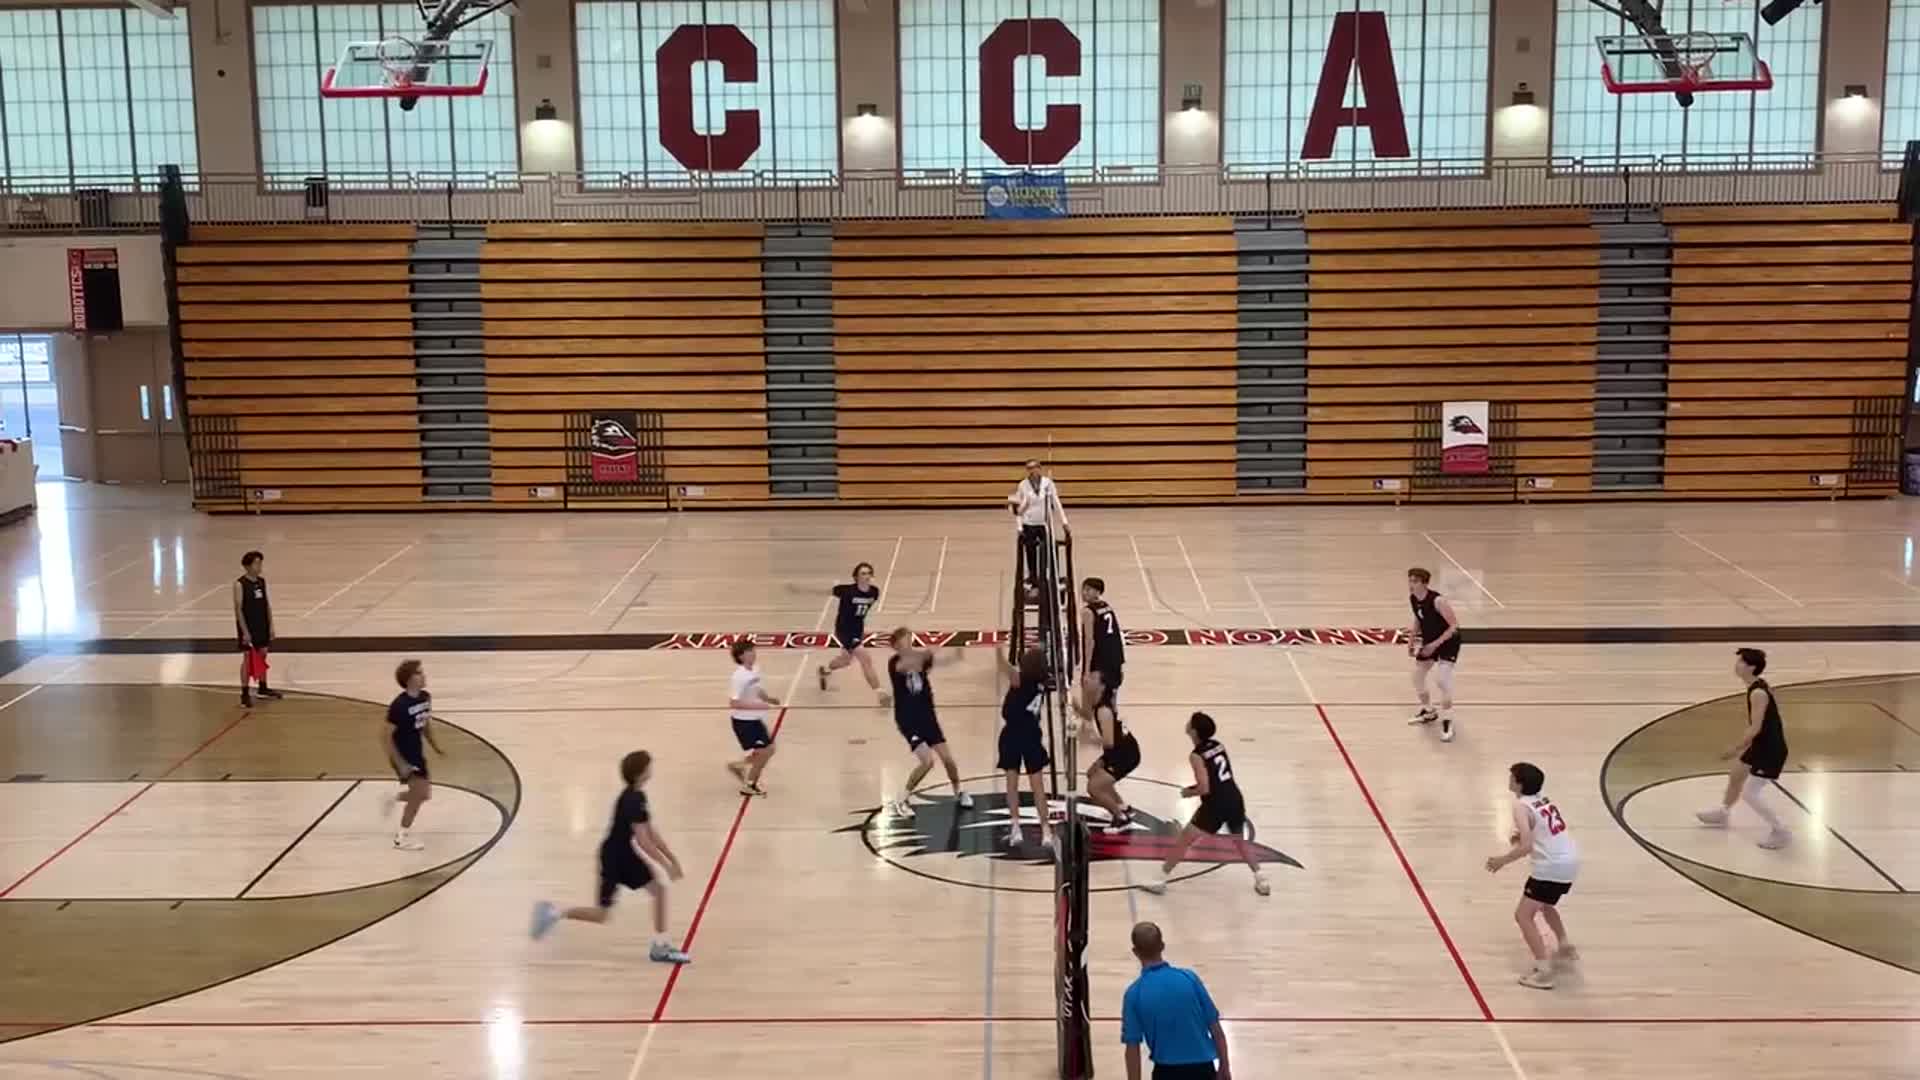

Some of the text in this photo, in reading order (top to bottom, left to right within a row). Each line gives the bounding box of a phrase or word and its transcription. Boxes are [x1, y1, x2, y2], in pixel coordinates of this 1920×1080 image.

[656, 11, 1411, 170] C C A
[71, 266, 86, 329] ROBOTICS
[1103, 612, 1114, 634] 7
[1025, 694, 1042, 717] 4
[1213, 754, 1232, 782] 2
[1540, 804, 1567, 837] 23
